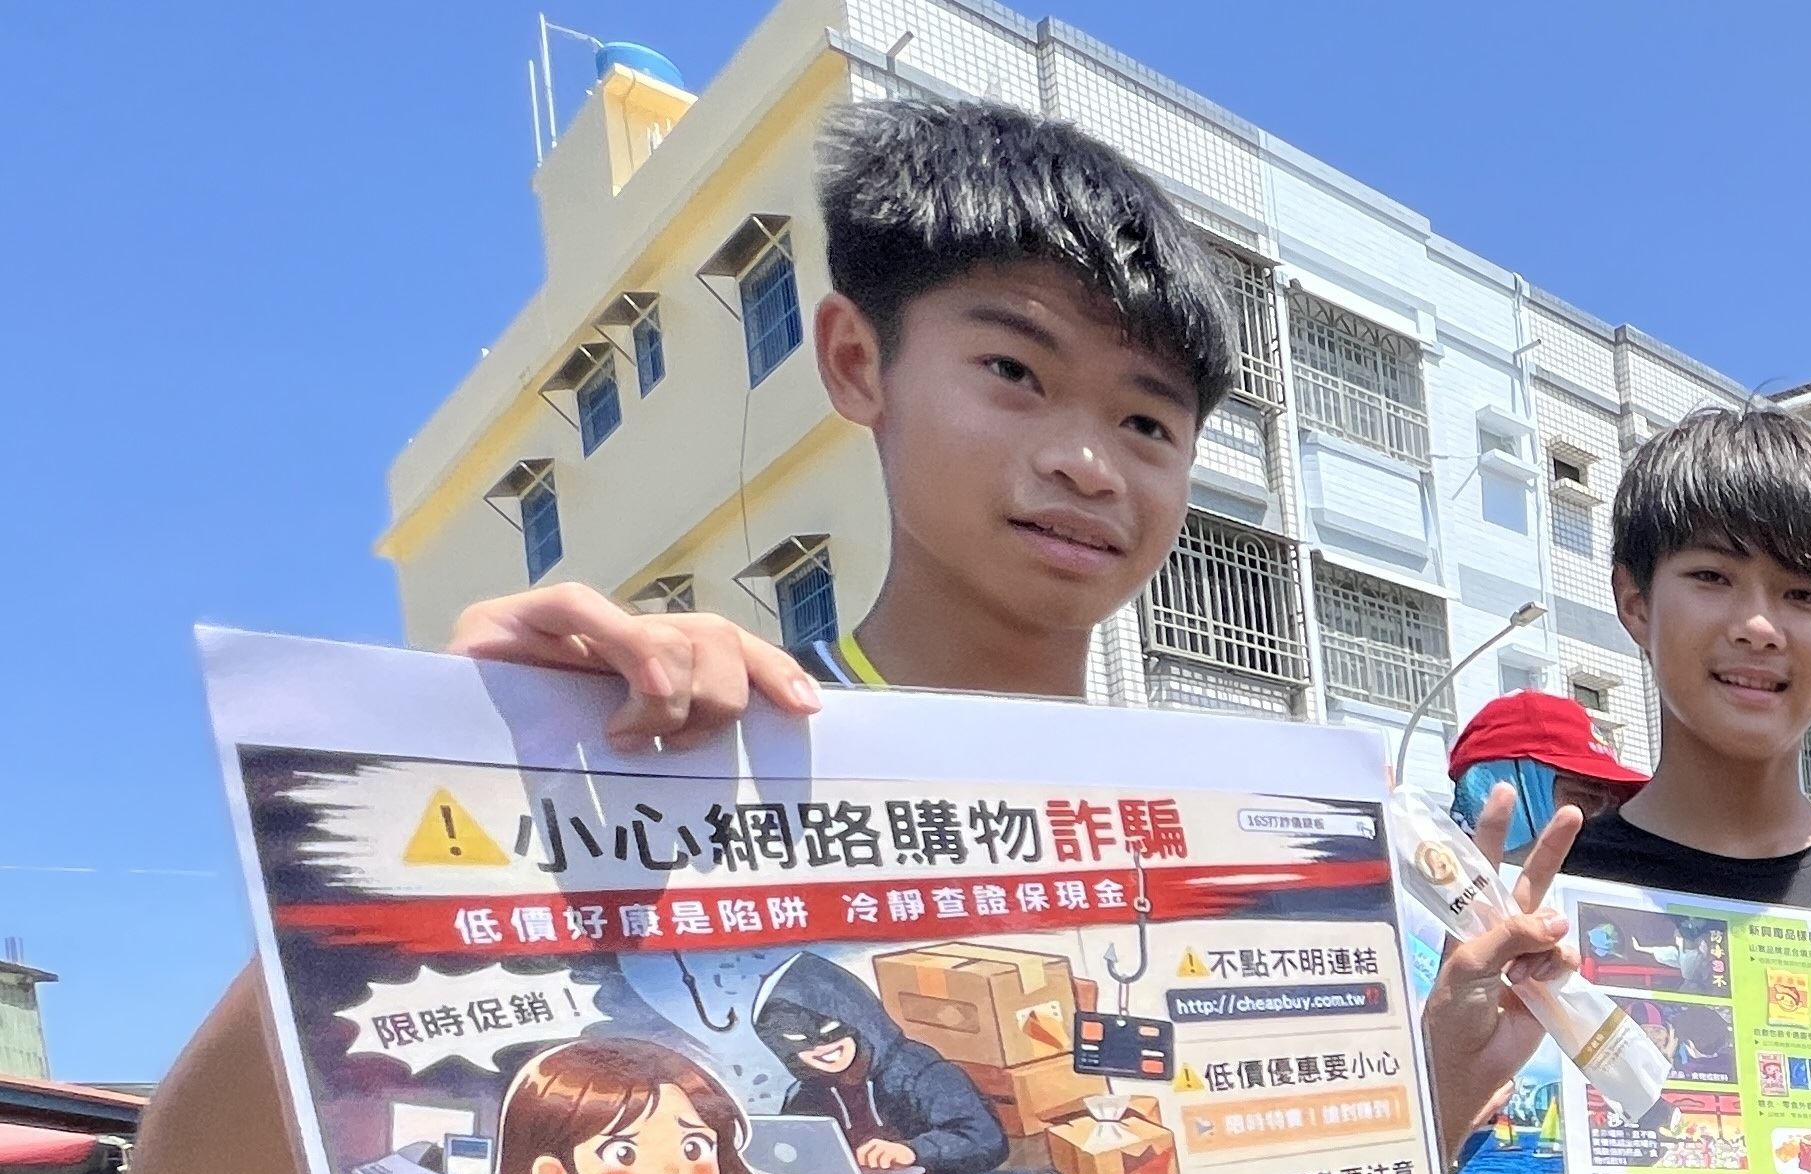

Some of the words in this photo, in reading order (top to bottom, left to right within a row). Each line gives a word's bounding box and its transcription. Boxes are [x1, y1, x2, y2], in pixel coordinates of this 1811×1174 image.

[514, 797, 1188, 873] 小心網路購物詐騙
[455, 896, 808, 945] 低價好康是陷阱
[842, 876, 1130, 924] 冷靜查證保現金
[1208, 947, 1379, 979] 不點不明連結
[372, 986, 582, 1049] 限時促銷！
[1176, 993, 1366, 1016] http://cheapbuy.com.tw
[1204, 1051, 1400, 1092] 低價優惠要小心
